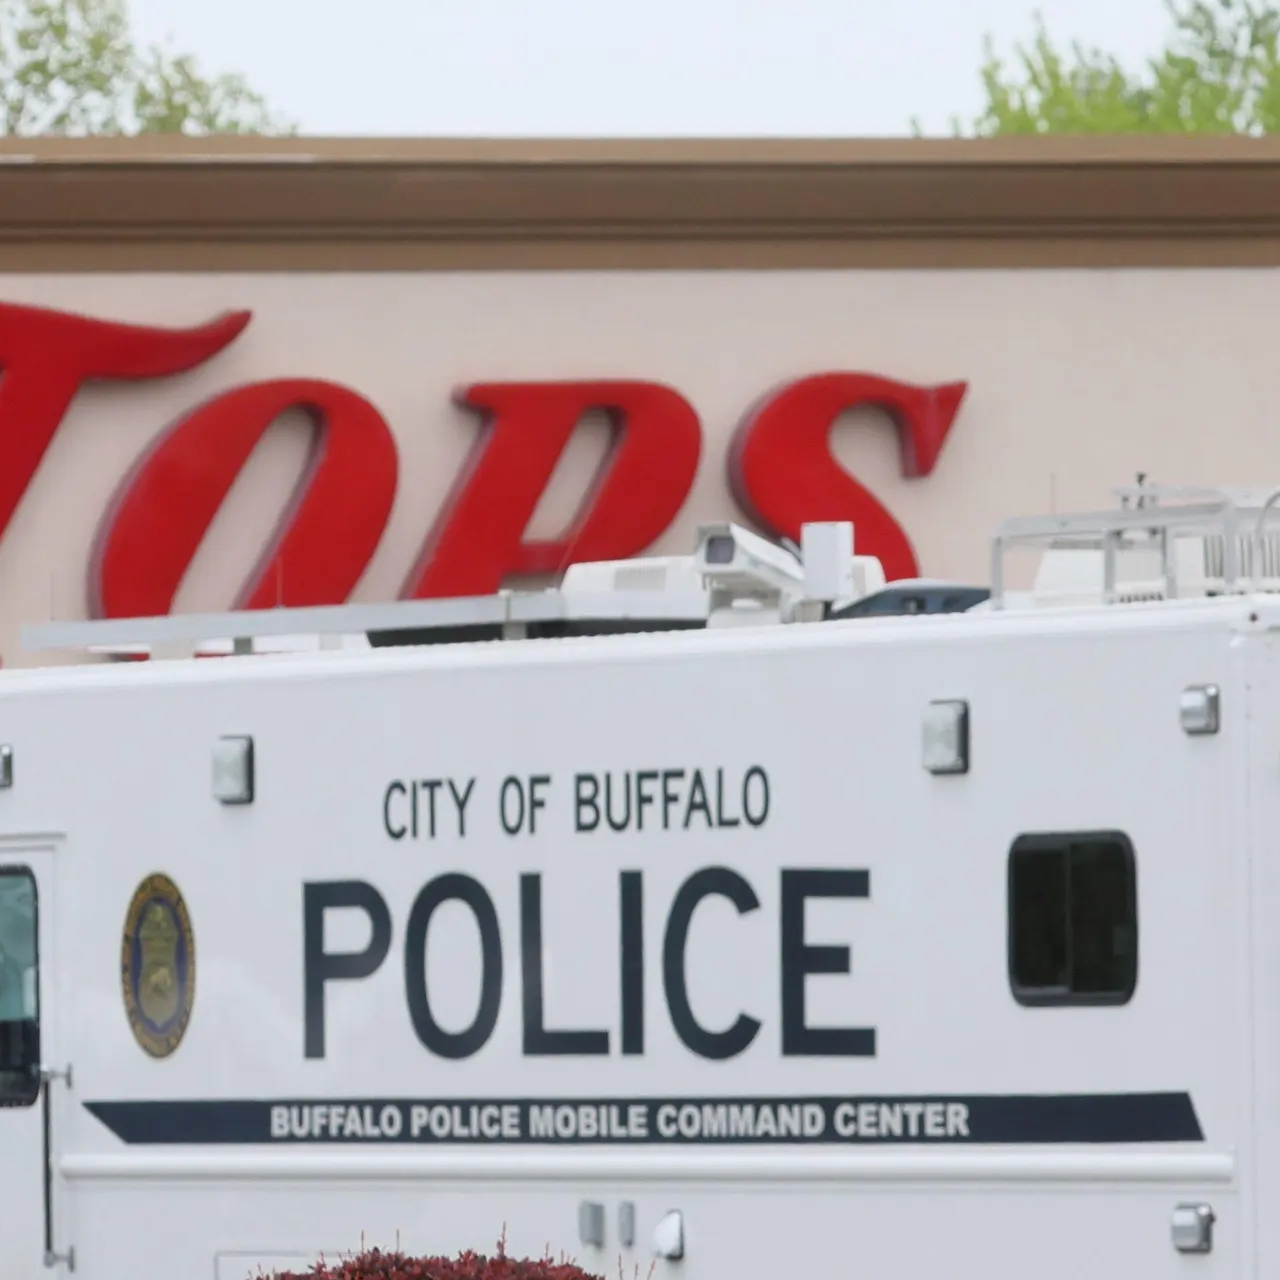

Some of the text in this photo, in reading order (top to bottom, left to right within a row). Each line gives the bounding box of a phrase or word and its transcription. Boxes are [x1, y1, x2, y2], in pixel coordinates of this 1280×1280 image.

[383, 765, 770, 840] CITY OF BUFFALO
[302, 865, 877, 1061] POLICE
[269, 1104, 970, 1138] BUFFALO POLICE MOBILE COMMAND CENTER
